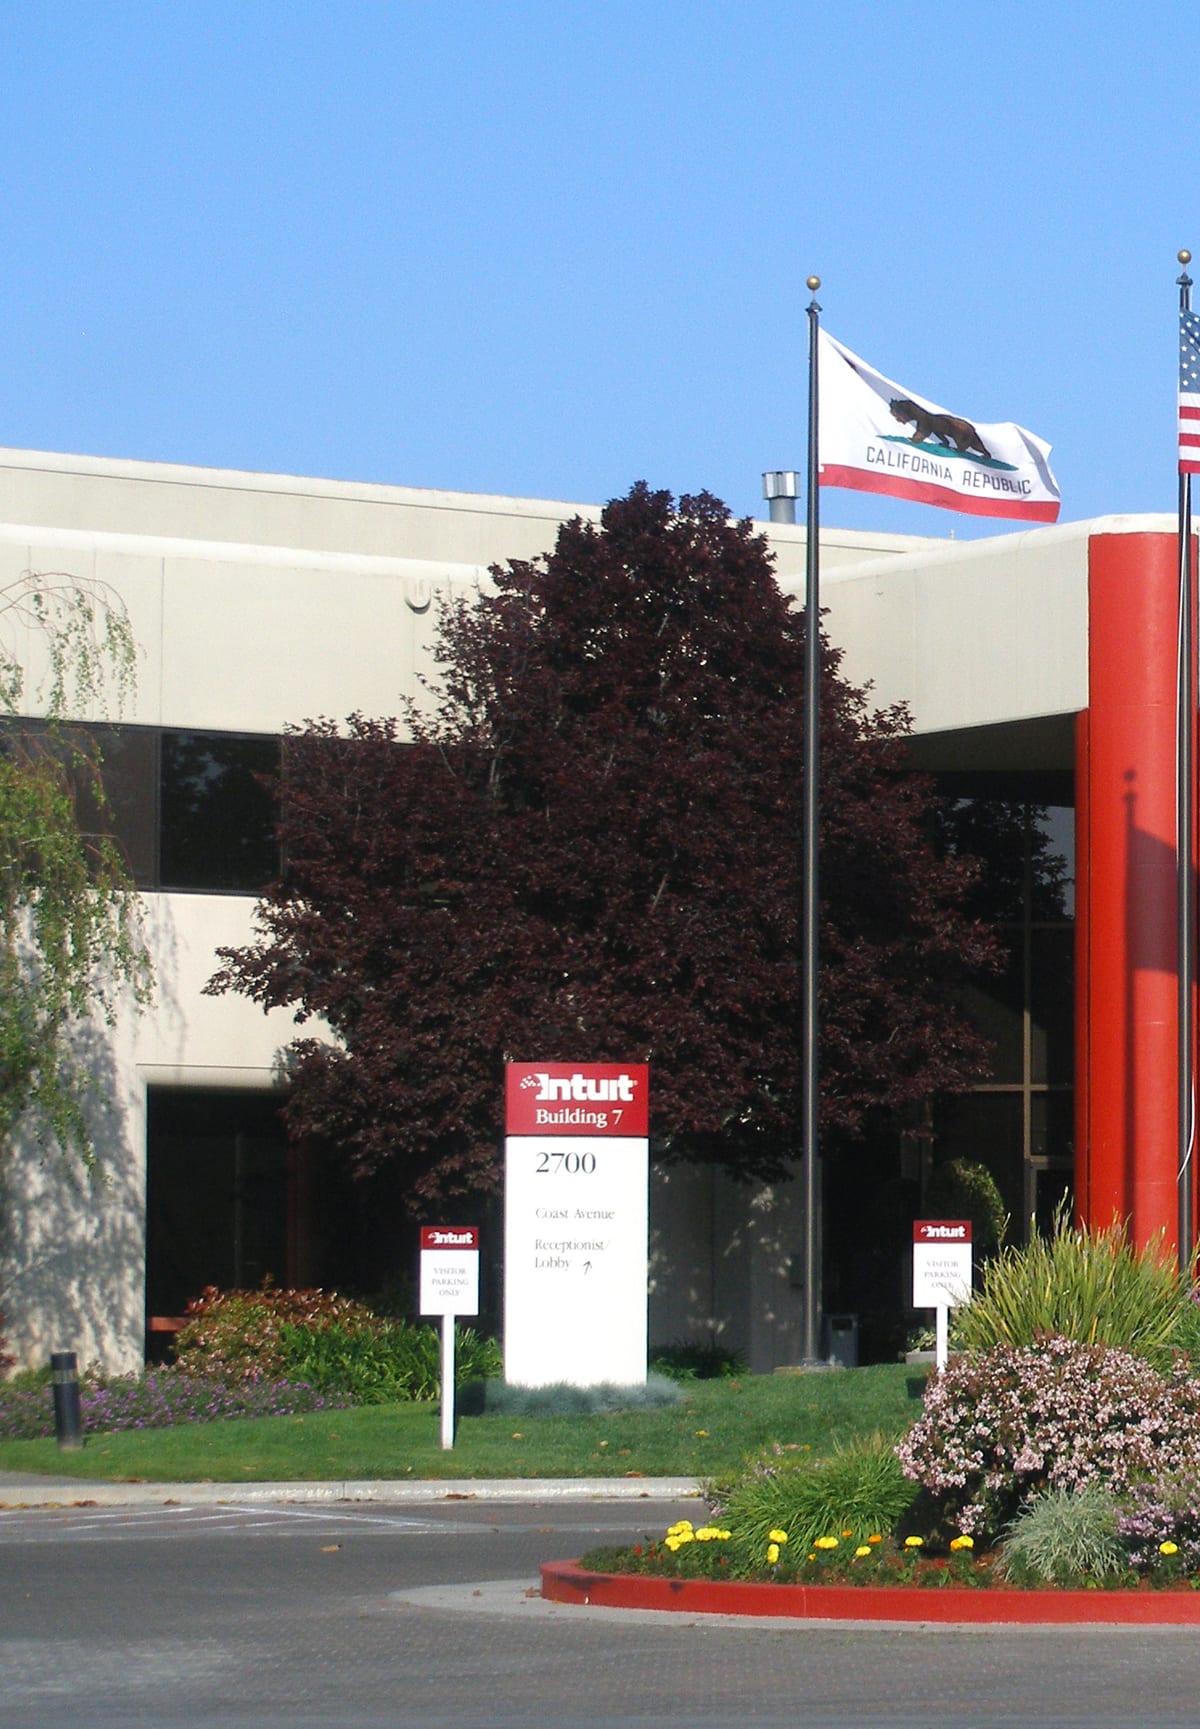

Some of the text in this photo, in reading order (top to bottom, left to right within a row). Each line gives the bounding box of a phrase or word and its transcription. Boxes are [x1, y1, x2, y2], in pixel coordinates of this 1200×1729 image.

[866, 446, 1032, 495] CALIFORNIA REPUBLIC
[534, 1073, 634, 1102] Intuit
[536, 1108, 624, 1129] Building 7
[536, 1152, 596, 1174] 2700
[535, 1207, 616, 1220] Coast Avenue
[433, 1231, 473, 1244] Intuit
[926, 1225, 966, 1238] Intuit
[534, 1256, 570, 1272] Lobby
[926, 1260, 959, 1268] VISITOR
[433, 1267, 467, 1275] VISITOR
[923, 1271, 961, 1279] PARKING
[431, 1278, 469, 1286] PARKING
[438, 1289, 461, 1297] ONLY
